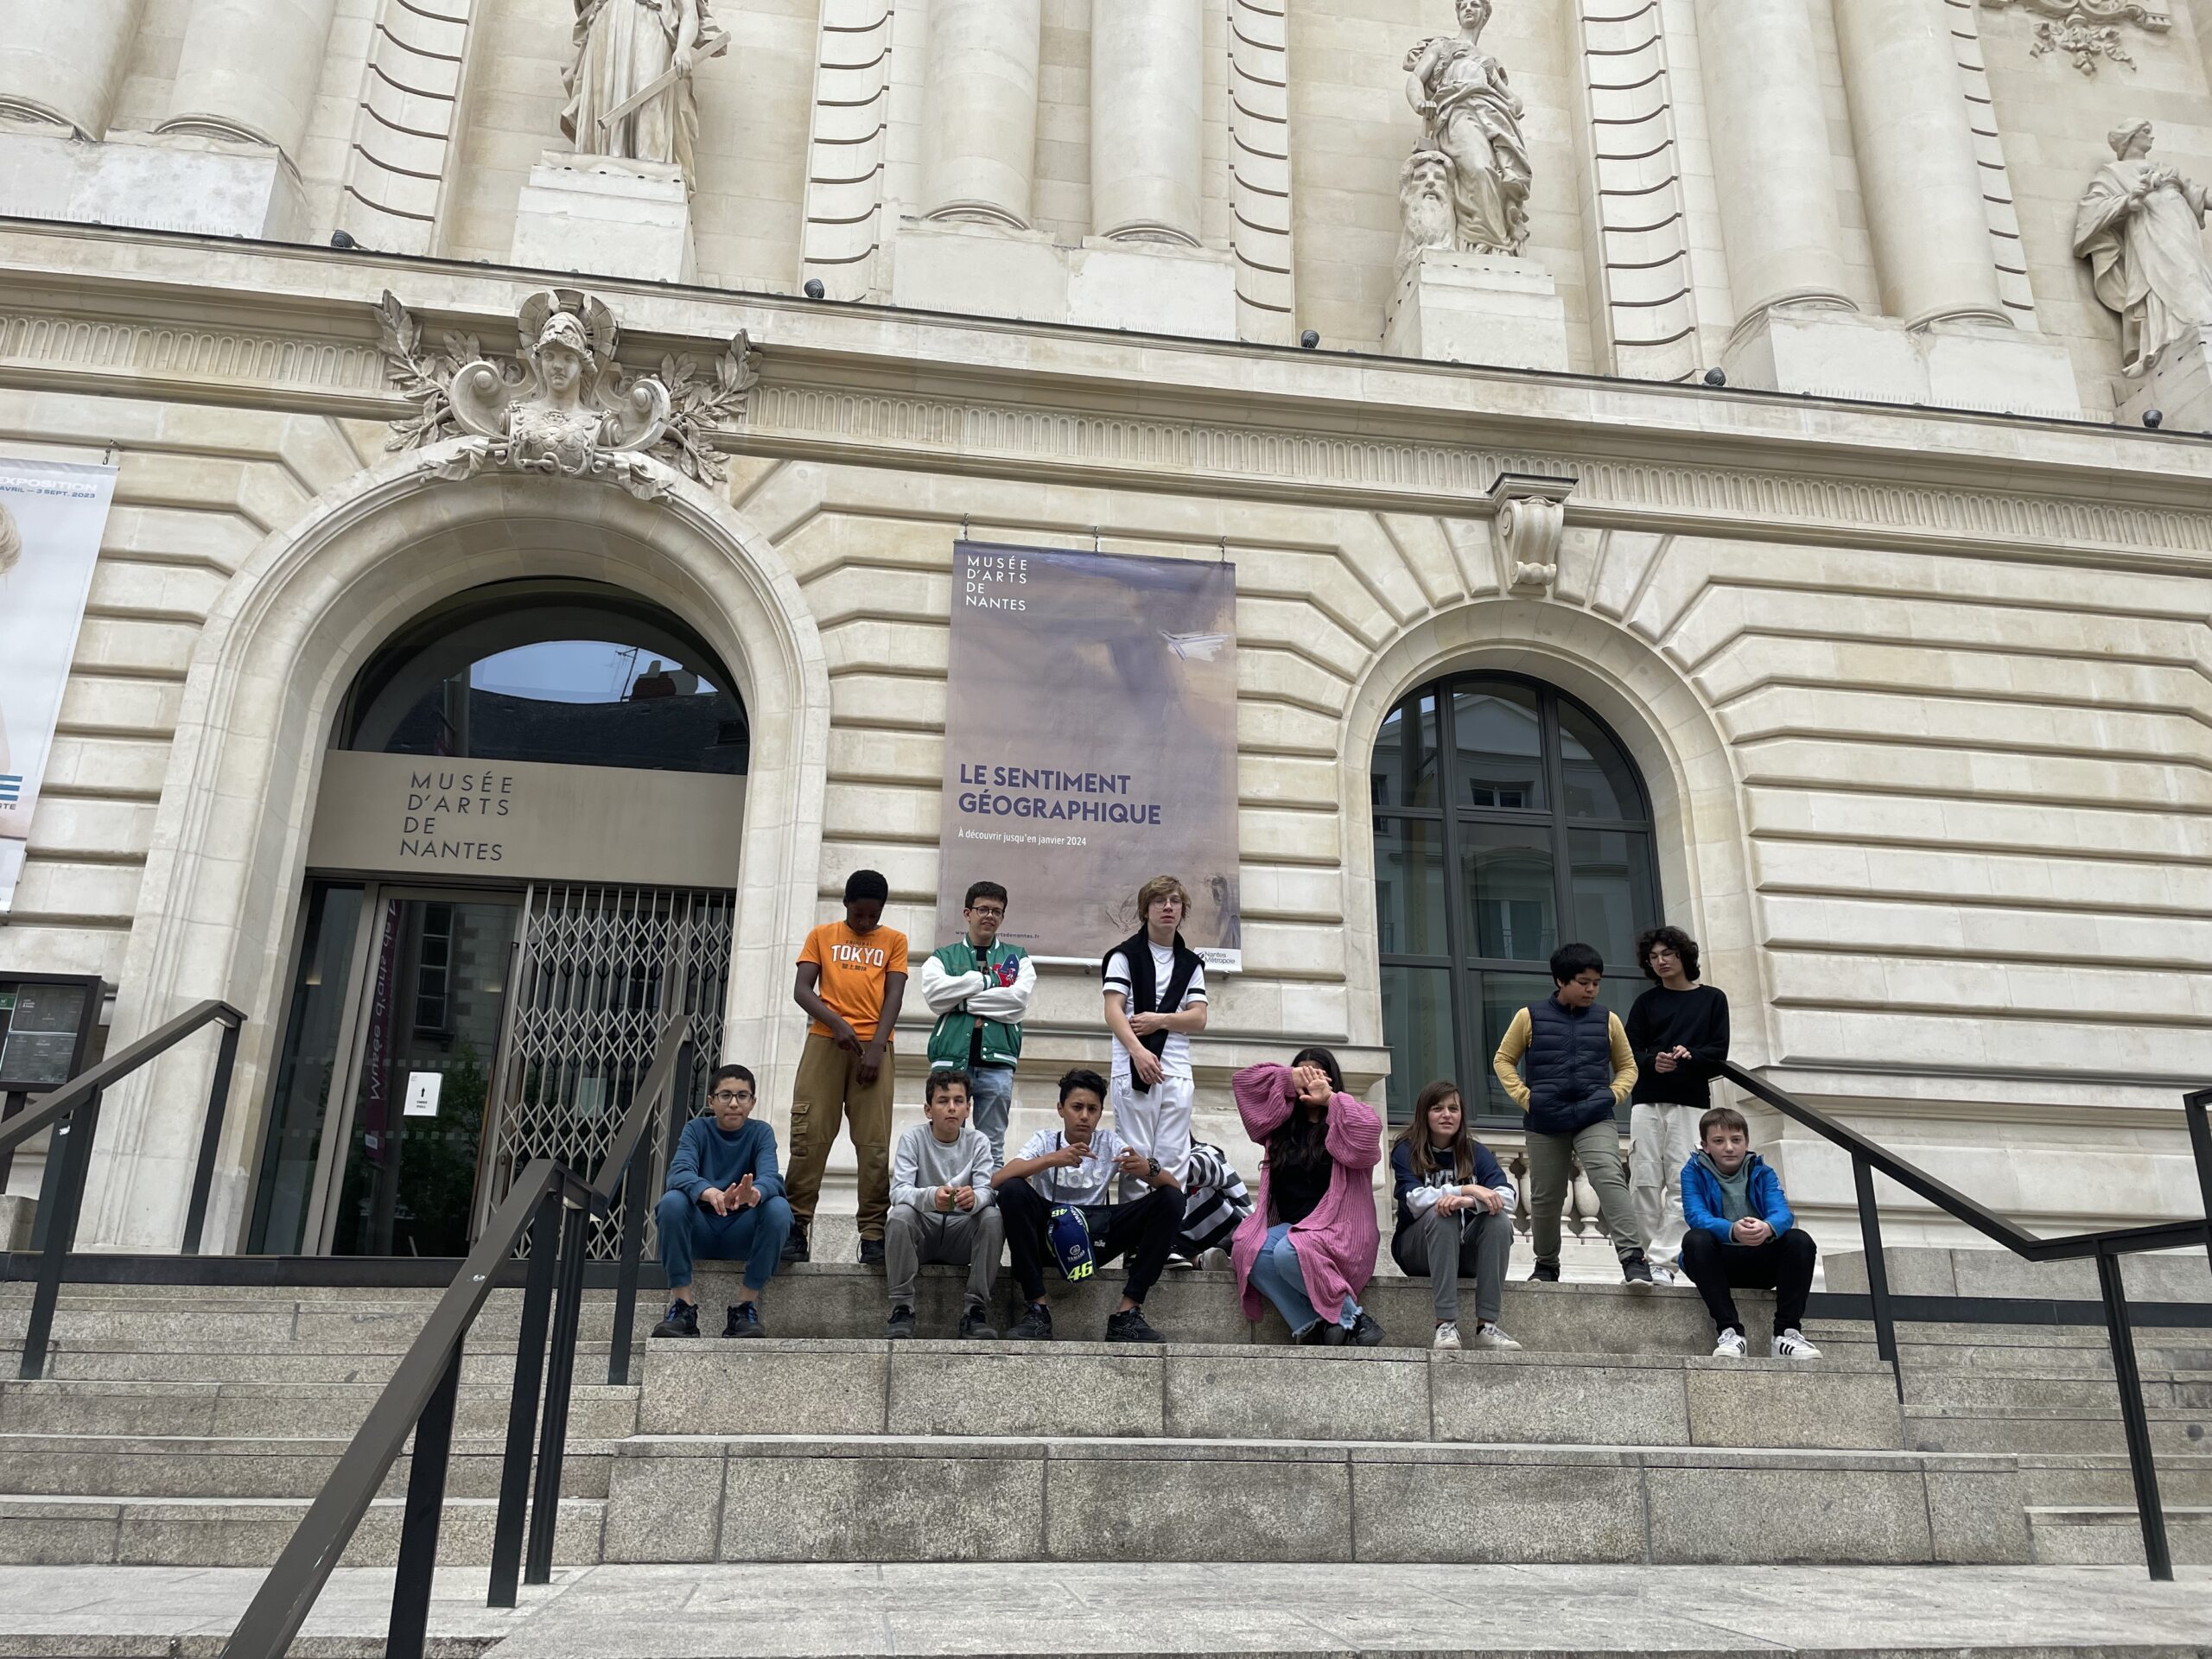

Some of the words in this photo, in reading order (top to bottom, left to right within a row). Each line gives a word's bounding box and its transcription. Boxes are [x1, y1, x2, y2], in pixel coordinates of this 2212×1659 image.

[0, 476, 98, 492] EXPOSITION
[968, 555, 1027, 570] MUSÉE
[967, 569, 1027, 584] D'ARTS
[966, 582, 985, 594] DE
[966, 594, 1027, 611] NANTES
[410, 770, 512, 793] MUSÉE
[960, 763, 987, 785] LE
[993, 766, 1131, 795] SENTIMENT
[407, 794, 509, 816] D'ARTS
[958, 789, 1161, 825] GÉOGRAPHIQUE
[404, 817, 435, 834] DE
[958, 826, 964, 838] À
[965, 829, 1002, 841] découvrir
[1002, 832, 1037, 844] jusqu'en
[1038, 834, 1065, 845] janvier
[1066, 836, 1087, 846] 2024
[400, 838, 503, 861] NANTES
[831, 944, 885, 968] TOKYO
[1049, 1166, 1103, 1189] BOSS
[1067, 1249, 1085, 1262] YAMAHA
[1067, 1260, 1093, 1281] 46
